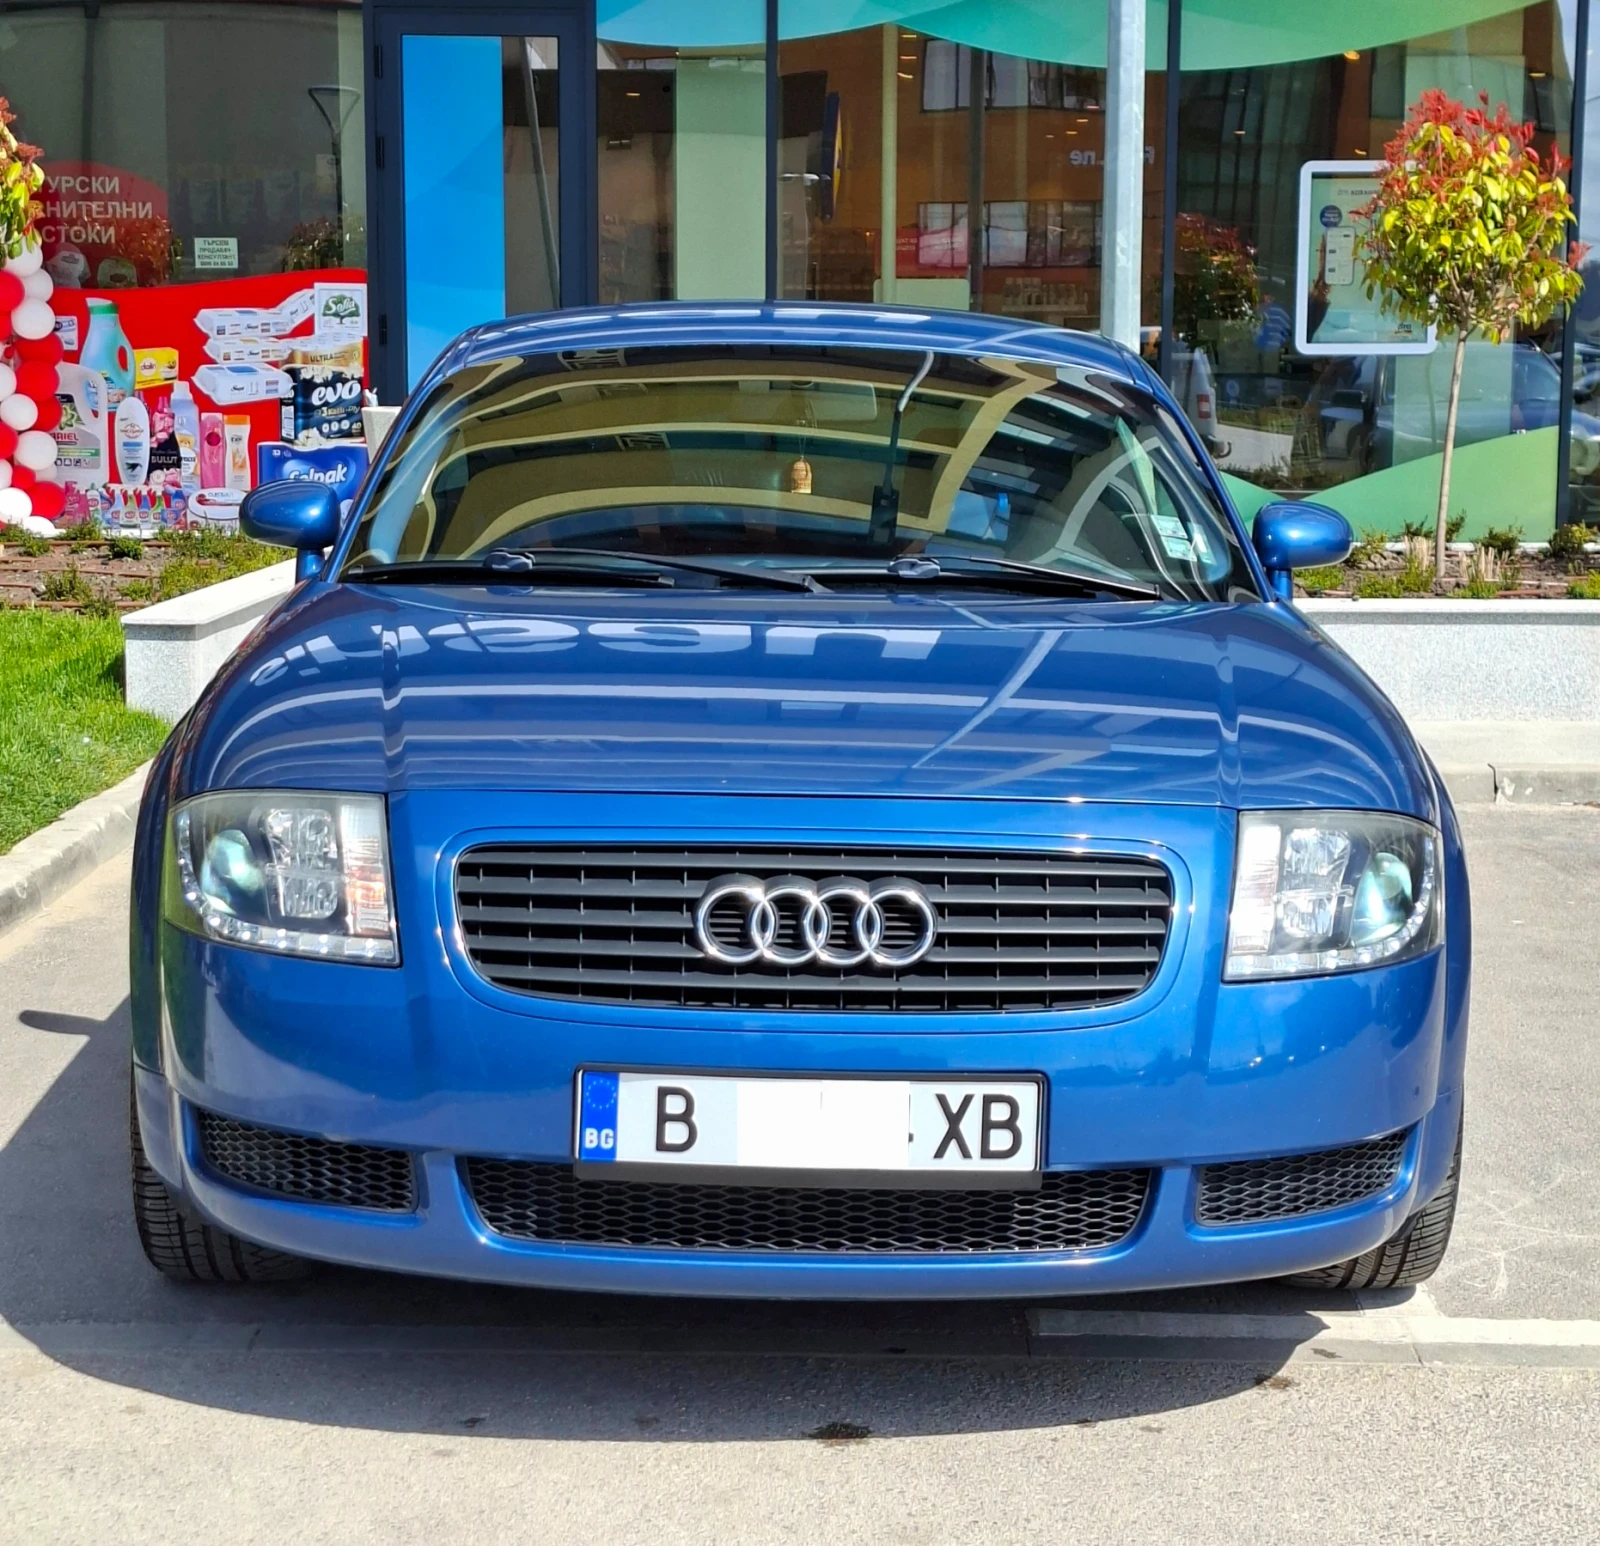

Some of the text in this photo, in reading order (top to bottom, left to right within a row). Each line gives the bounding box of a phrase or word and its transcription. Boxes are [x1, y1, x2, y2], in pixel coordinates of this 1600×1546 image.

[39, 176, 119, 194] УРСКИ
[46, 200, 153, 218] НИТЕЛНИ
[41, 225, 116, 244] СТОКИ
[311, 380, 361, 406] evo
[655, 1085, 1023, 1161] B XB
[584, 1127, 615, 1150] BG
